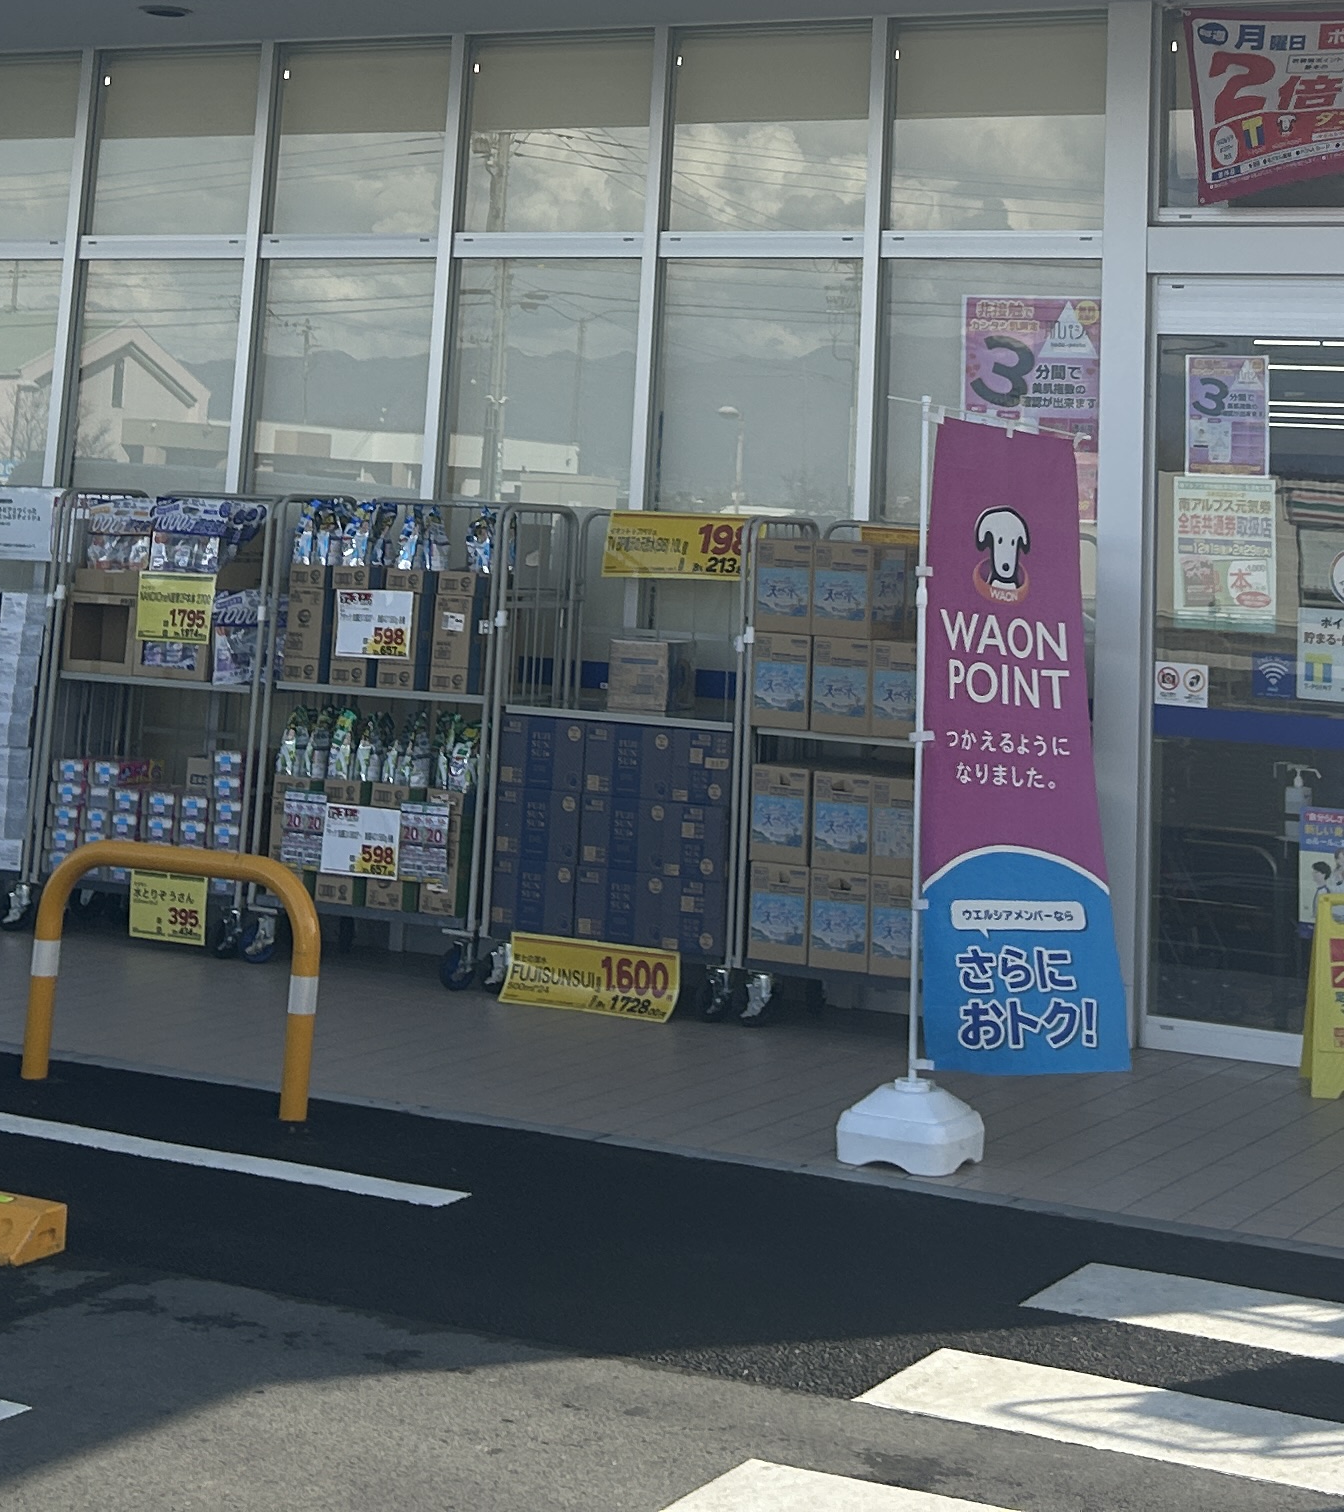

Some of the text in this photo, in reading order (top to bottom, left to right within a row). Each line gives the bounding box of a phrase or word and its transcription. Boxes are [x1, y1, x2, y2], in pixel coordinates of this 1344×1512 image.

[1234, 24, 1306, 51] 月曜日
[1209, 51, 1344, 122] 2倍
[970, 334, 1035, 408] 3
[1035, 363, 1082, 381] 分間で
[1192, 377, 1230, 417] 3
[706, 556, 738, 574] 213
[989, 586, 1019, 604] WAON
[169, 609, 206, 628] 1795
[373, 627, 405, 645] 598
[939, 609, 1068, 662] WAON
[948, 658, 1070, 710] POINT
[946, 727, 1071, 758] つかえるように
[955, 760, 1058, 790] なりました。
[361, 844, 394, 865] 598
[167, 906, 200, 927] 395
[960, 907, 1075, 925] ウエルシアメンバーなら
[509, 964, 596, 989] FUJISUNSUI
[955, 945, 1077, 992] さらに
[956, 997, 1098, 1050] おトク!
